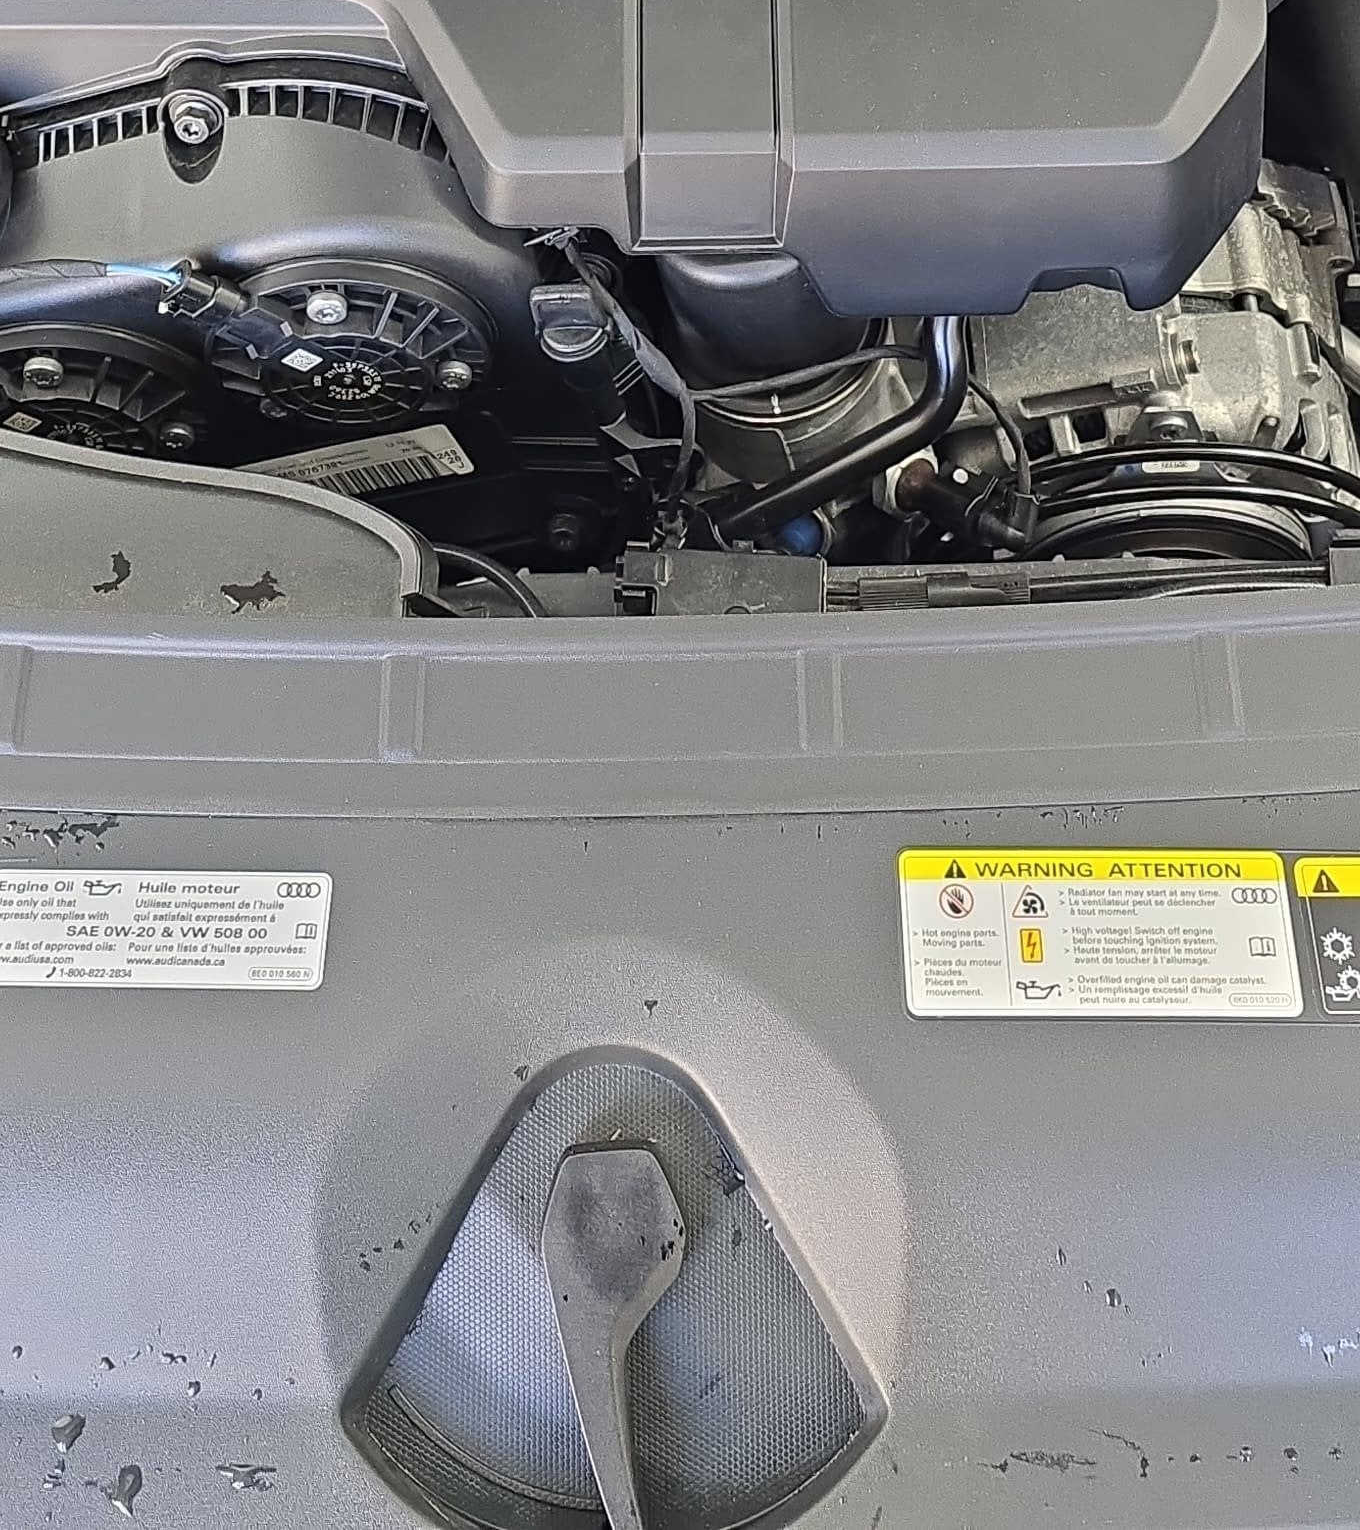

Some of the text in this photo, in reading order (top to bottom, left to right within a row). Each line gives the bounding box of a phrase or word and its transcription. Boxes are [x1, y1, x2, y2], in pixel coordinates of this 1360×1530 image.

[975, 862, 1242, 879] WARNING ATTENTION
[54, 880, 74, 892] Oil
[138, 881, 241, 895] Huile moteur
[1067, 887, 1222, 900] Radiator fan may start at any time.
[16, 898, 39, 909] only
[40, 897, 54, 907] oil
[56, 898, 77, 908] that
[135, 899, 285, 911] Utilisez uniquement de l'huile
[1068, 898, 1080, 907] Le
[1081, 898, 1130, 907] ventilateur
[1131, 898, 1152, 909] peut
[1154, 899, 1165, 907] se
[40, 911, 86, 922] complies
[87, 911, 110, 921] with
[133, 912, 151, 923] qui
[152, 913, 193, 922] satisfait
[1077, 907, 1096, 917] tout
[1098, 908, 1139, 917] moment.
[66, 925, 268, 939] SAE 0W-20 & VW 508 00
[922, 928, 999, 939] Hot engine parts.
[1071, 926, 1093, 938] High
[1133, 926, 1167, 936] Switch
[1167, 926, 1181, 936] off
[1182, 927, 1214, 938] engine
[5, 943, 13, 951] a
[14, 940, 30, 951] list
[31, 941, 43, 951] of
[44, 941, 93, 953] approved
[95, 941, 117, 951] oils:
[922, 939, 986, 948] Moving parts.
[1072, 936, 1219, 947] before touching ignition system.
[127, 942, 152, 952] Pour
[154, 944, 175, 953] une
[176, 942, 198, 953] liste
[200, 942, 241, 954] d'huiles
[1073, 946, 1100, 955] Haute
[1173, 946, 1183, 956] le
[1184, 948, 1218, 956] moteur
[126, 957, 225, 967] www.audicanada.ca
[923, 958, 953, 967] Pièces
[954, 958, 967, 967] du
[1074, 957, 1100, 965] avant
[1101, 956, 1114, 965] de
[1116, 956, 1150, 965] toucher
[59, 968, 133, 978] 1-800-822-2834
[924, 969, 965, 977] chaudes.
[925, 978, 953, 987] Pièces
[1077, 975, 1267, 987] Overfilled engine oil can damage catalyst.
[925, 989, 984, 997] mouvement.
[1078, 985, 1223, 996] Un remplissage excessif d'huile
[1079, 996, 1101, 1006] peut
[1102, 995, 1126, 1004] nuire
[1128, 996, 1140, 1004] au
